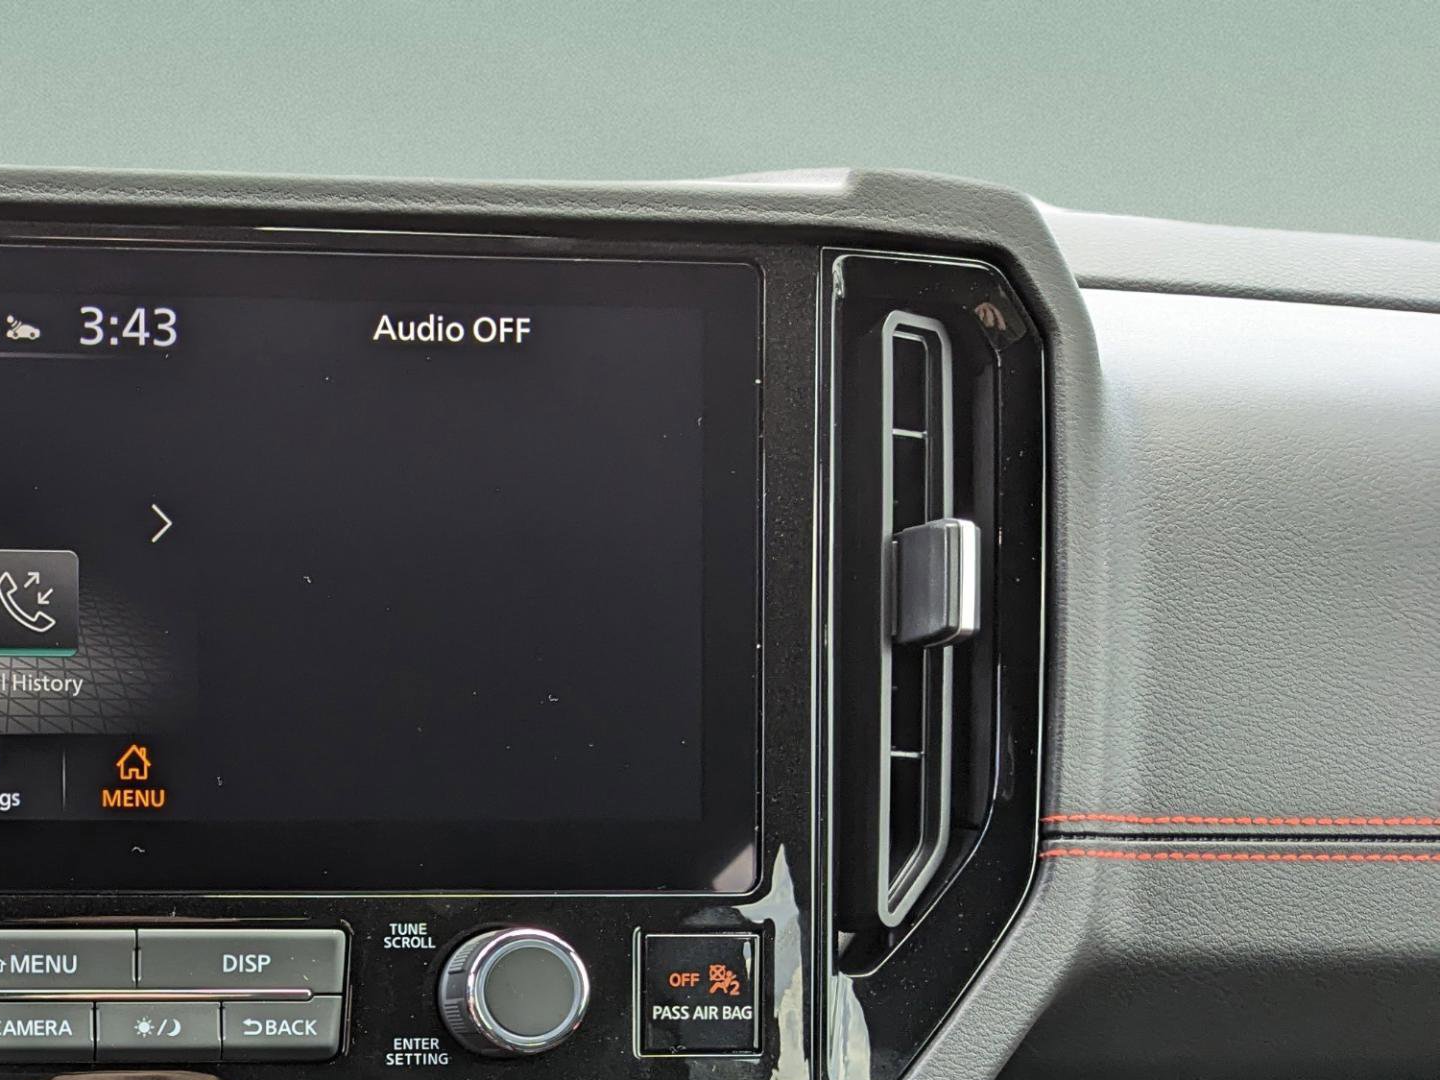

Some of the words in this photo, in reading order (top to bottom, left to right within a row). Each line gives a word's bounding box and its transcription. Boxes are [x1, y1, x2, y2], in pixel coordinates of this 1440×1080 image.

[79, 306, 179, 347] 3:43
[373, 313, 465, 343] Audio
[472, 316, 532, 344] OFF
[10, 671, 84, 697] History
[101, 788, 166, 809] MENU
[388, 922, 428, 936] TUNE
[383, 935, 436, 950] SCROLL
[9, 954, 78, 975] MENU
[221, 954, 272, 974] DISP
[669, 972, 700, 988] OFF
[652, 1005, 691, 1021] PASS
[692, 1005, 719, 1021] AIR
[722, 1005, 753, 1021] BAG
[265, 1018, 318, 1037] BACK
[392, 1037, 441, 1051] ENTER
[384, 1051, 450, 1068] SETTING
